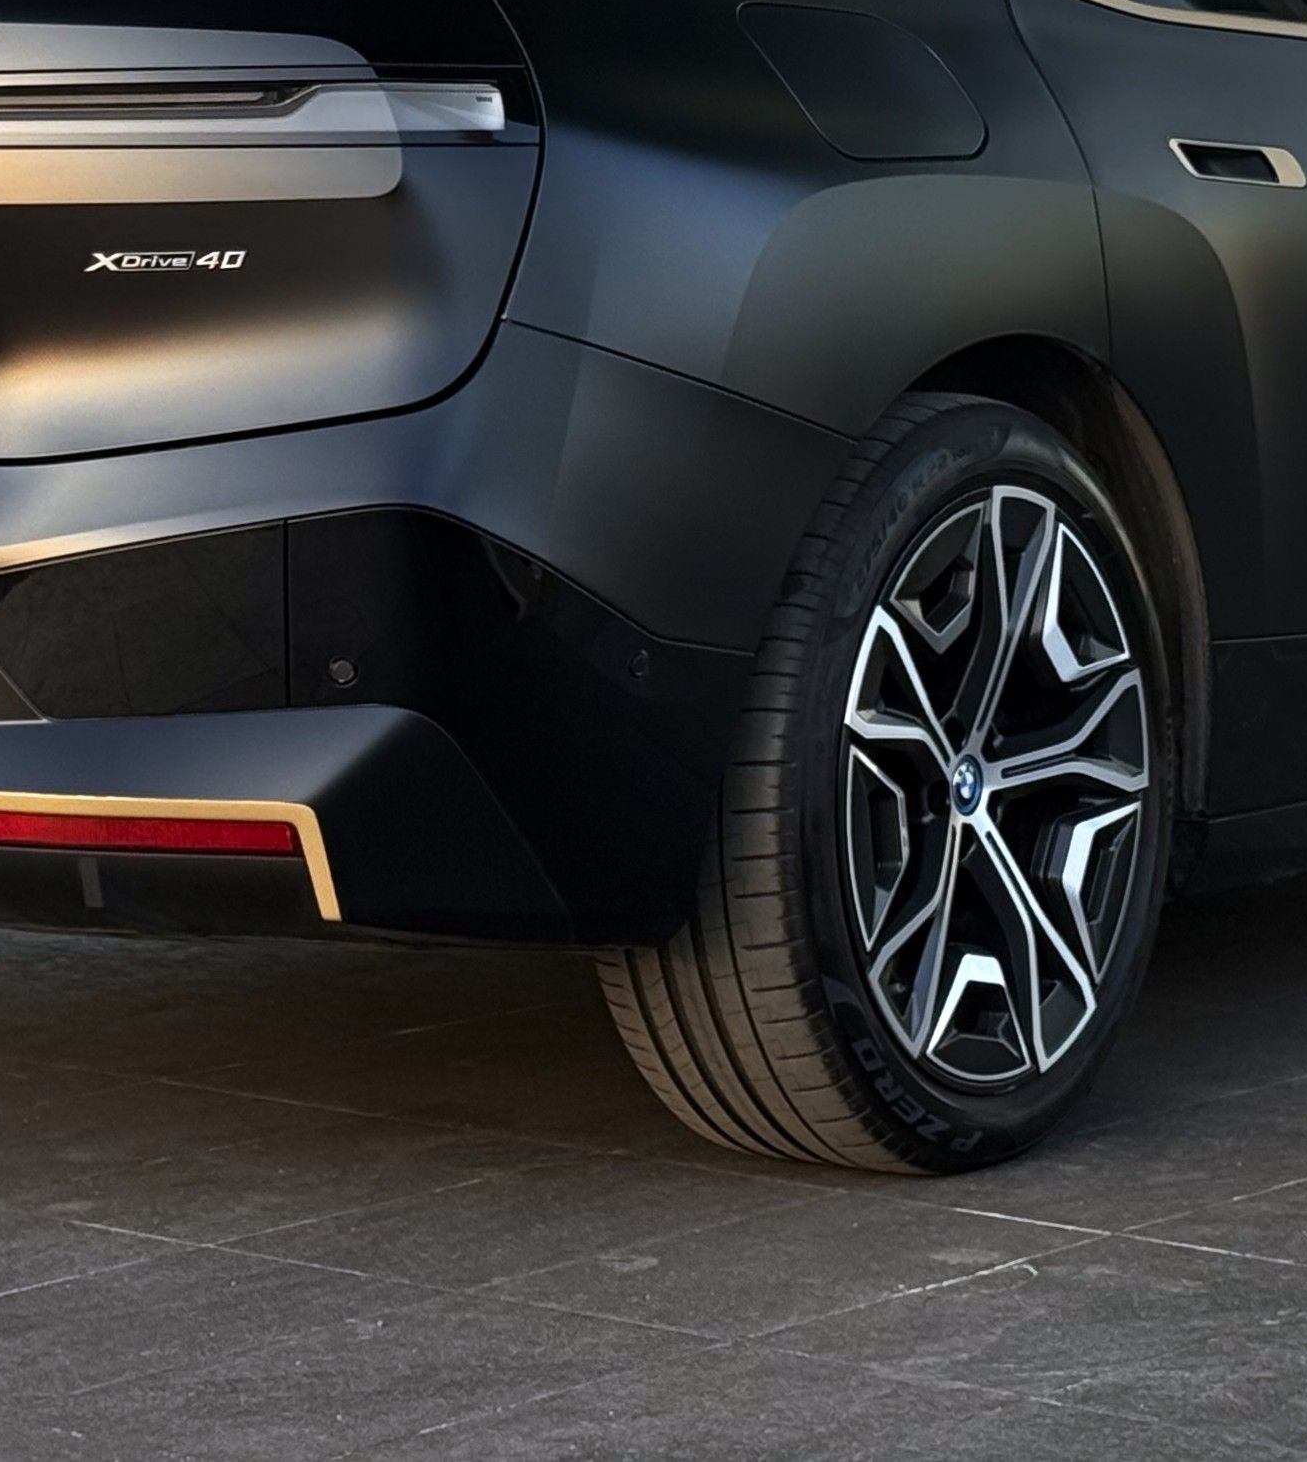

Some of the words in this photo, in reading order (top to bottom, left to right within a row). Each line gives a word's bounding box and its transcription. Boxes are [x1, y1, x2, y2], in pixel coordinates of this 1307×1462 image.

[196, 250, 248, 270] 40
[850, 1038, 952, 1142] ZERO
[949, 1131, 984, 1153] P
